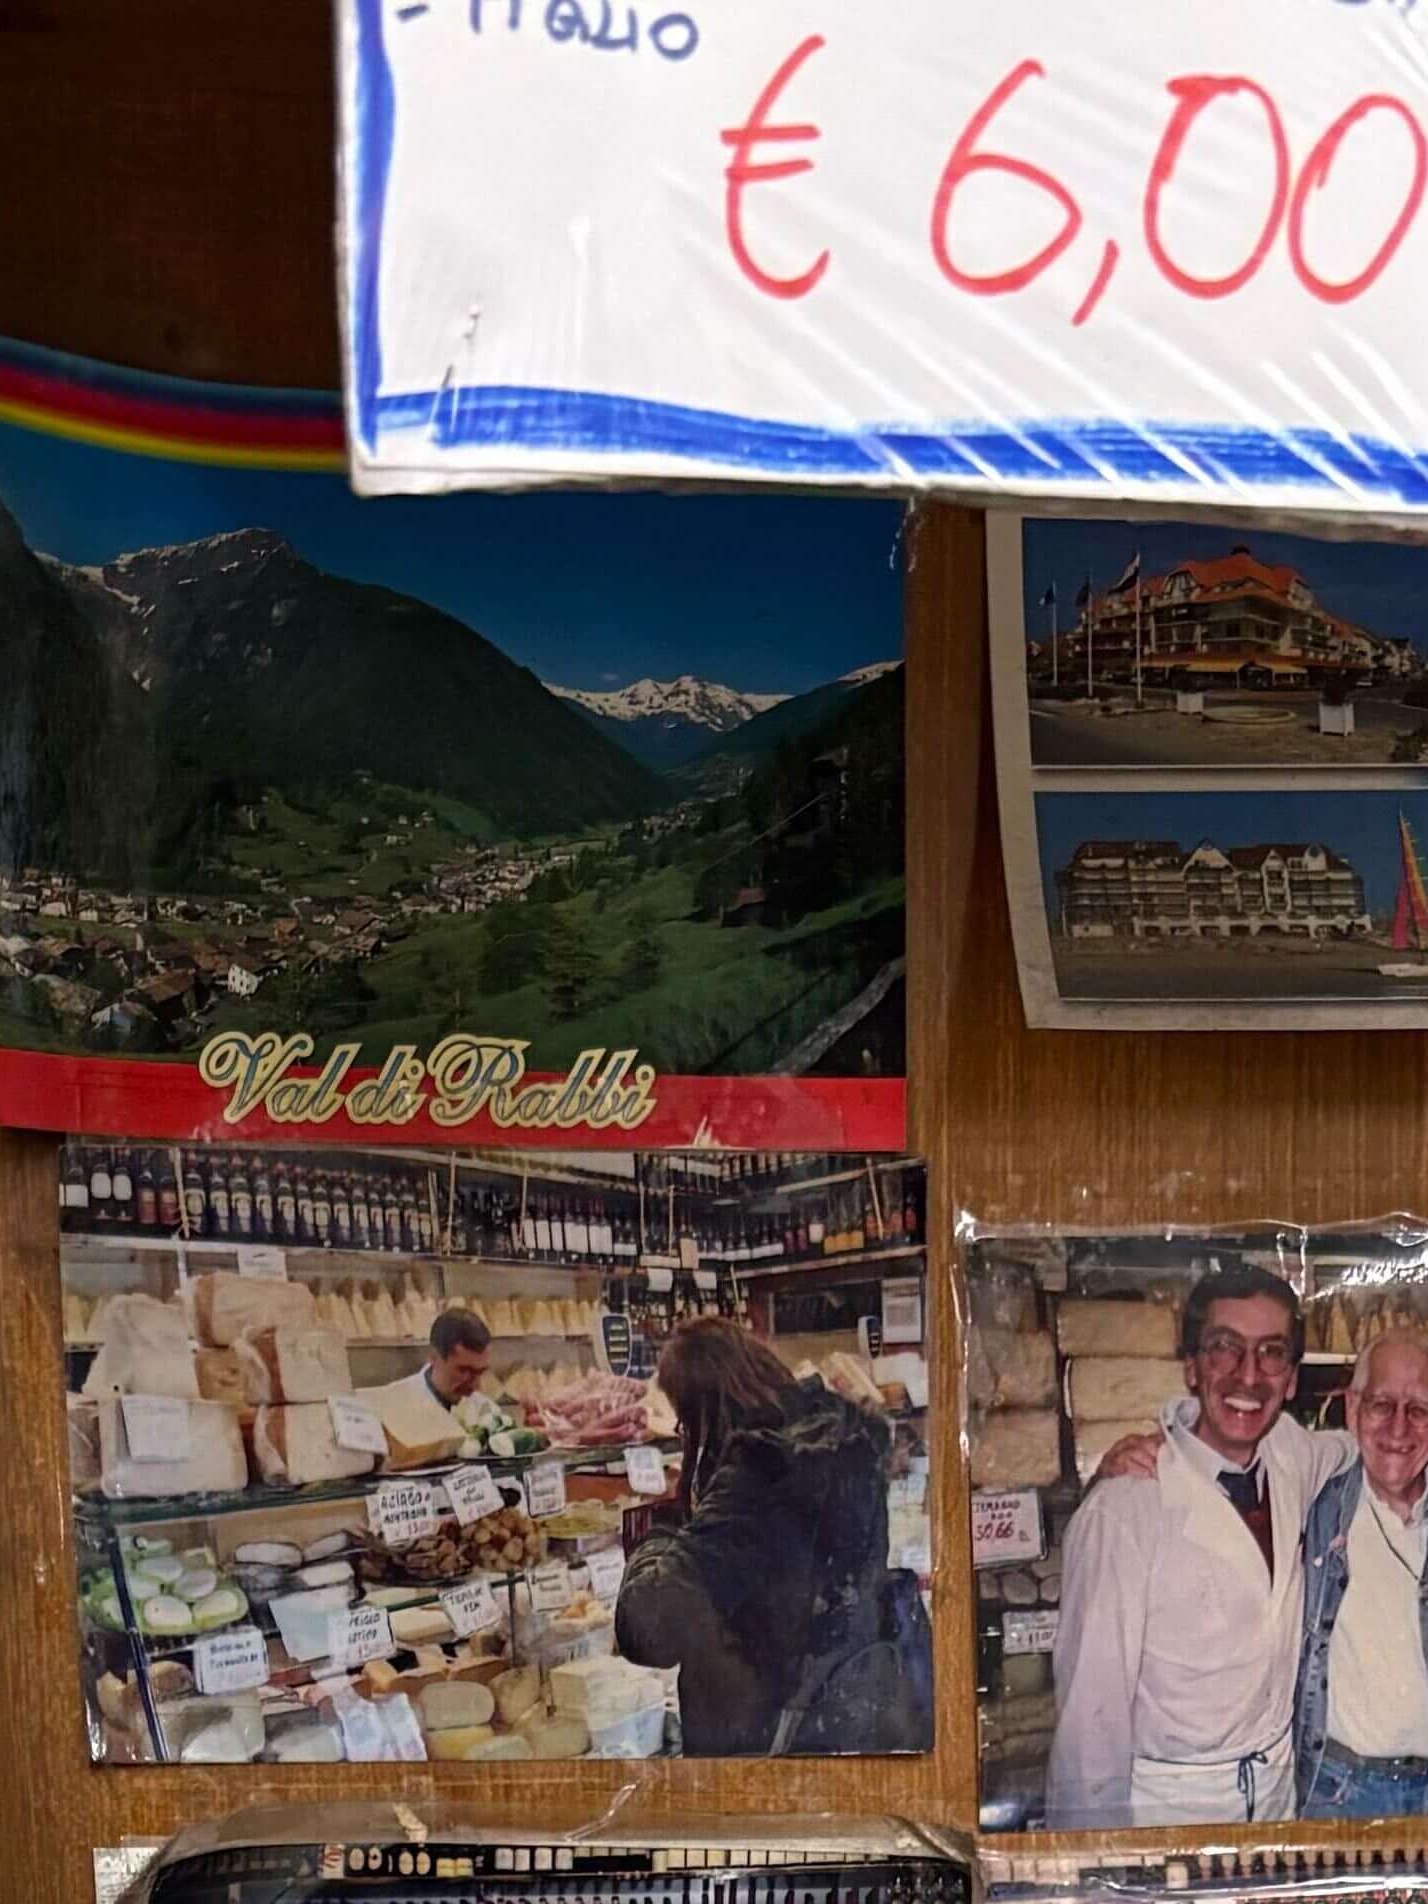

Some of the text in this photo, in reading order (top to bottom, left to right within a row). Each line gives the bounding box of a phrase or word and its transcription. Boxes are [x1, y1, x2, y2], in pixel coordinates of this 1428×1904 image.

[720, 35, 832, 298] €
[199, 1031, 658, 1130] Val di Rabbi
